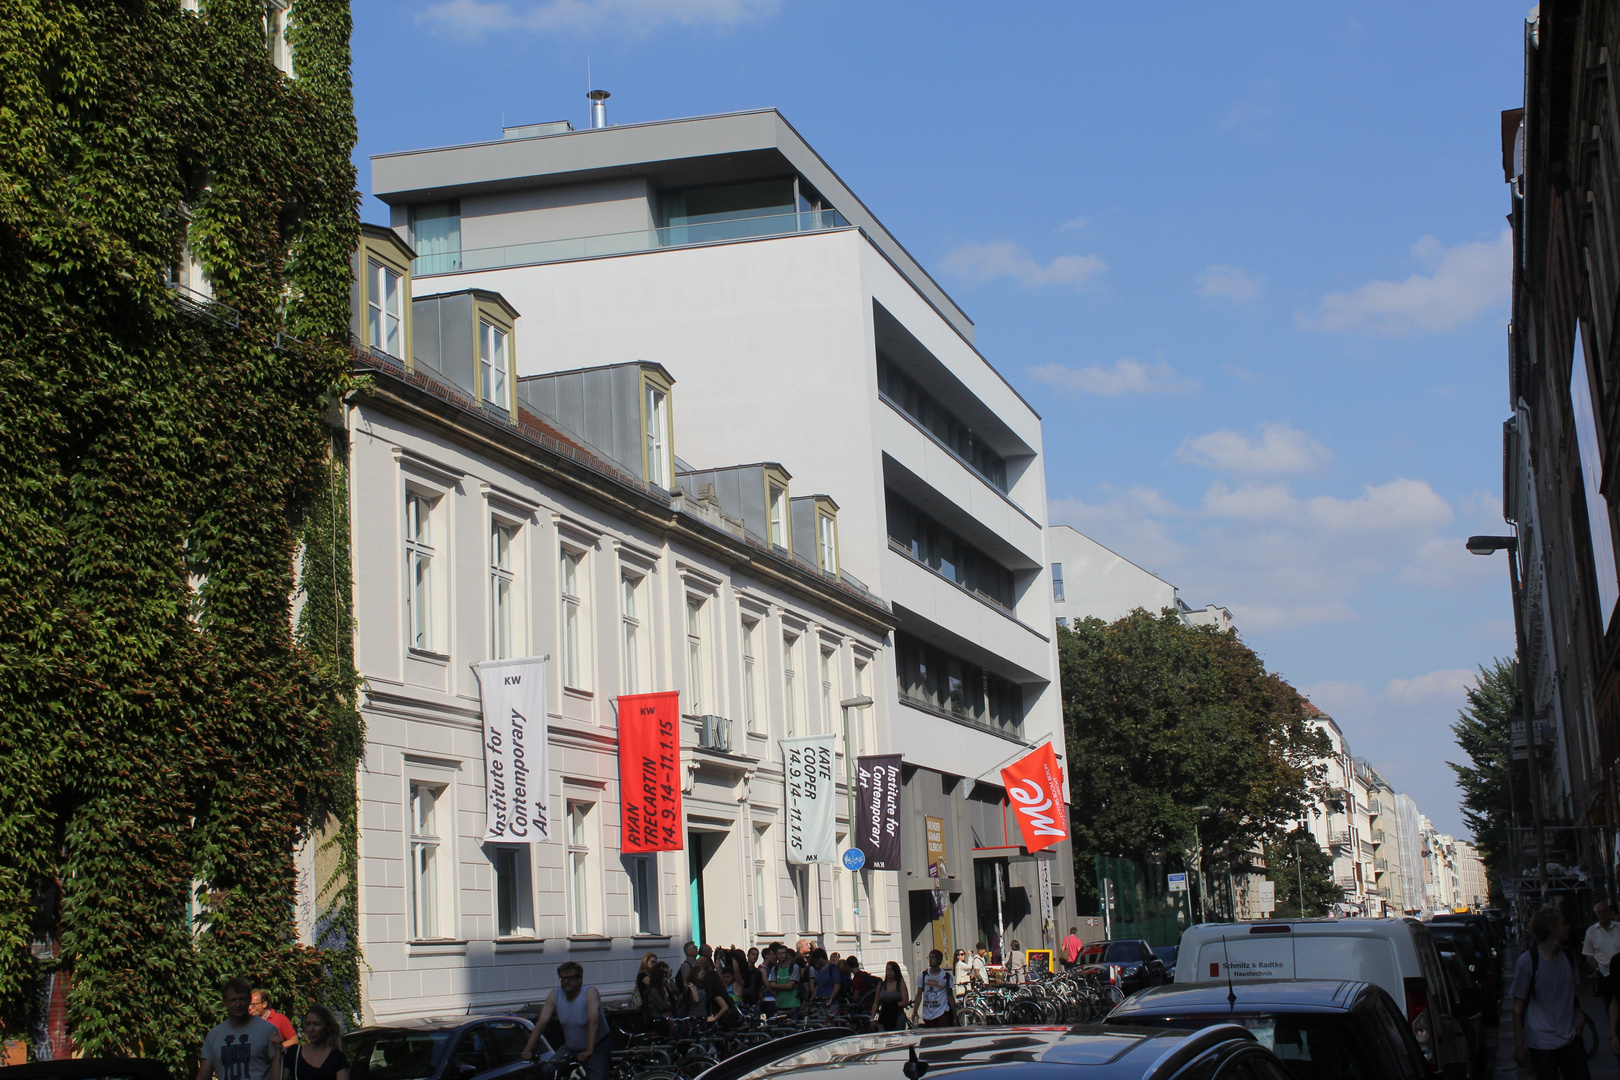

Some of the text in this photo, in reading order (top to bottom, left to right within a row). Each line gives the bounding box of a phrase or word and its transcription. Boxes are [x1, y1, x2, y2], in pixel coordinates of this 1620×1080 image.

[504, 676, 521, 686] KW
[640, 707, 655, 716] KW
[486, 727, 506, 837] Institute for
[509, 708, 530, 838] Contemporary
[804, 746, 816, 800] COOPER
[819, 746, 830, 781] KATE
[859, 766, 871, 789] Art
[1043, 763, 1052, 782] BERLIN
[642, 757, 658, 846] TRECARTIN
[870, 765, 886, 848] Contemporary
[886, 764, 900, 837] Institute for
[1010, 778, 1066, 836] me
[1048, 781, 1058, 798] ROOM
[532, 802, 548, 836] Art
[627, 802, 641, 847] RYAN
[1054, 798, 1067, 830] COLLECTORS
